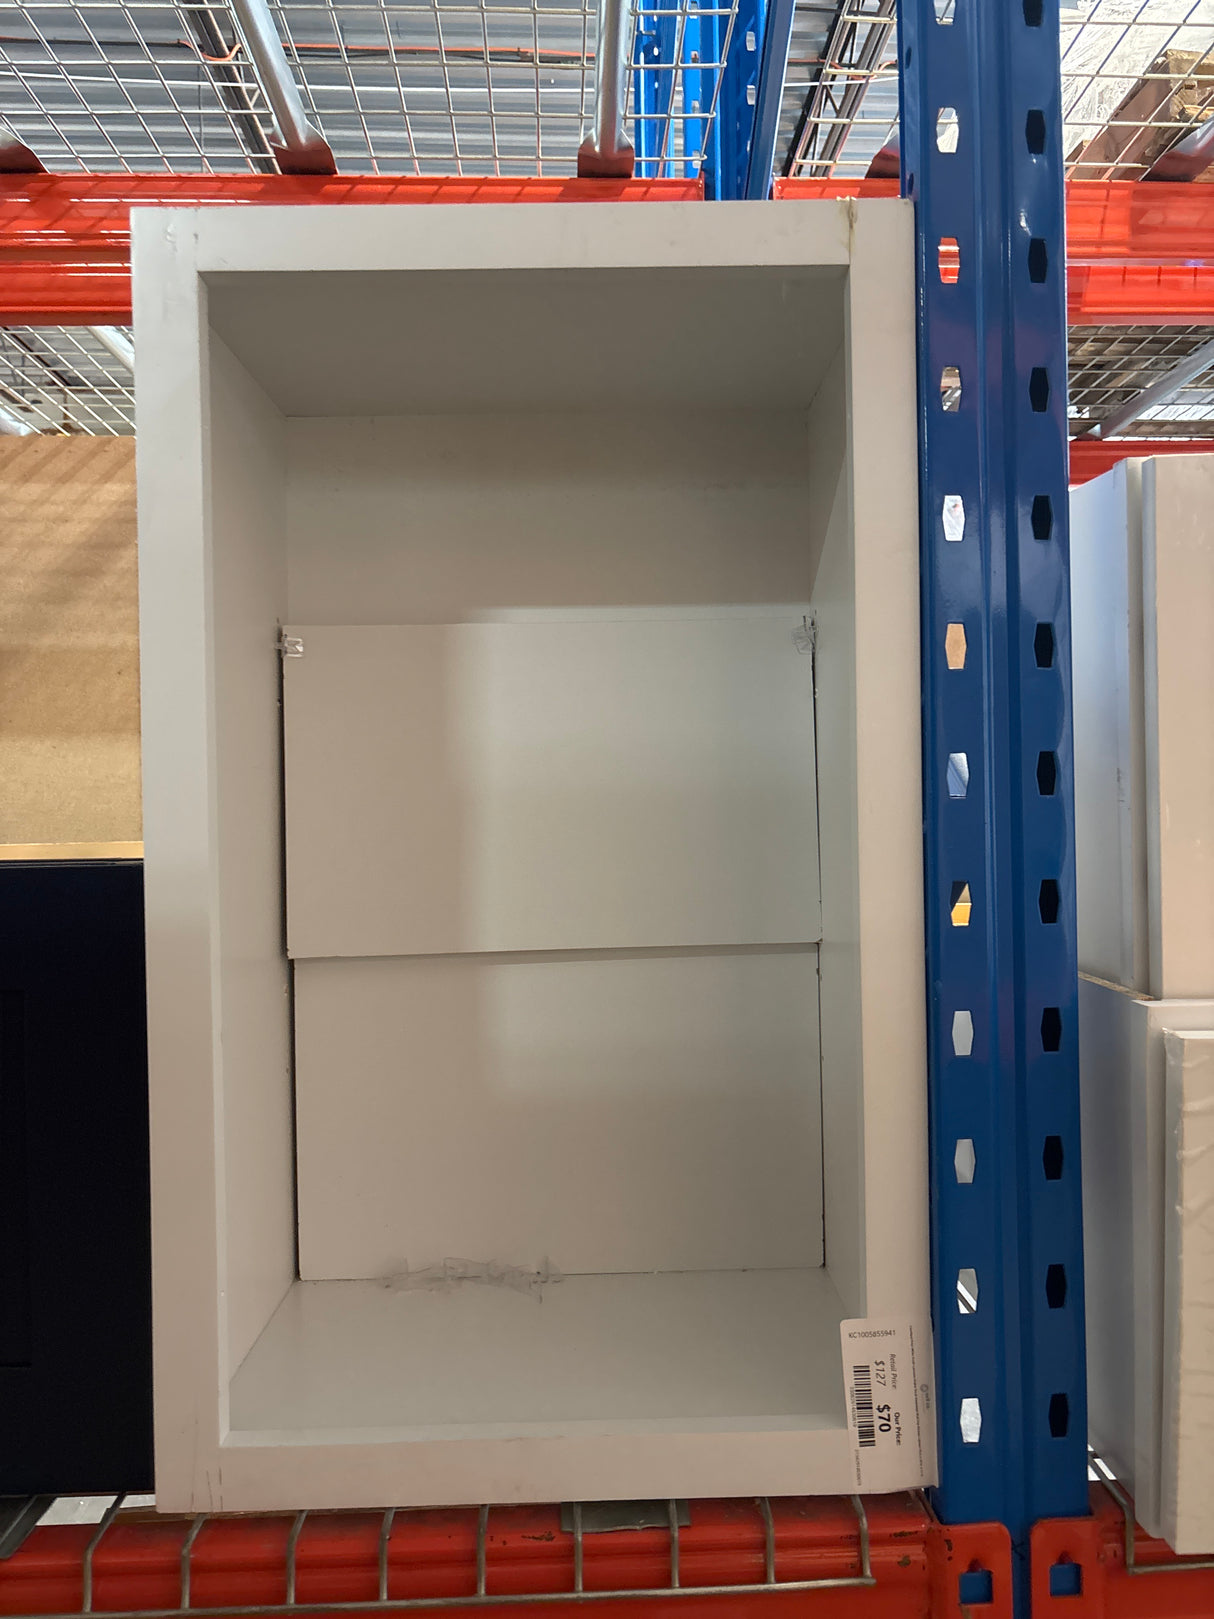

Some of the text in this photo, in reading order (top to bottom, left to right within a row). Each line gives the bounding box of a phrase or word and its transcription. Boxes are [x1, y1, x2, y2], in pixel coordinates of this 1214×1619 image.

[848, 1329, 896, 1339] KC1005855941
[874, 1359, 887, 1387] $127
[889, 1353, 897, 1372] Retail
[876, 1403, 892, 1433] $70
